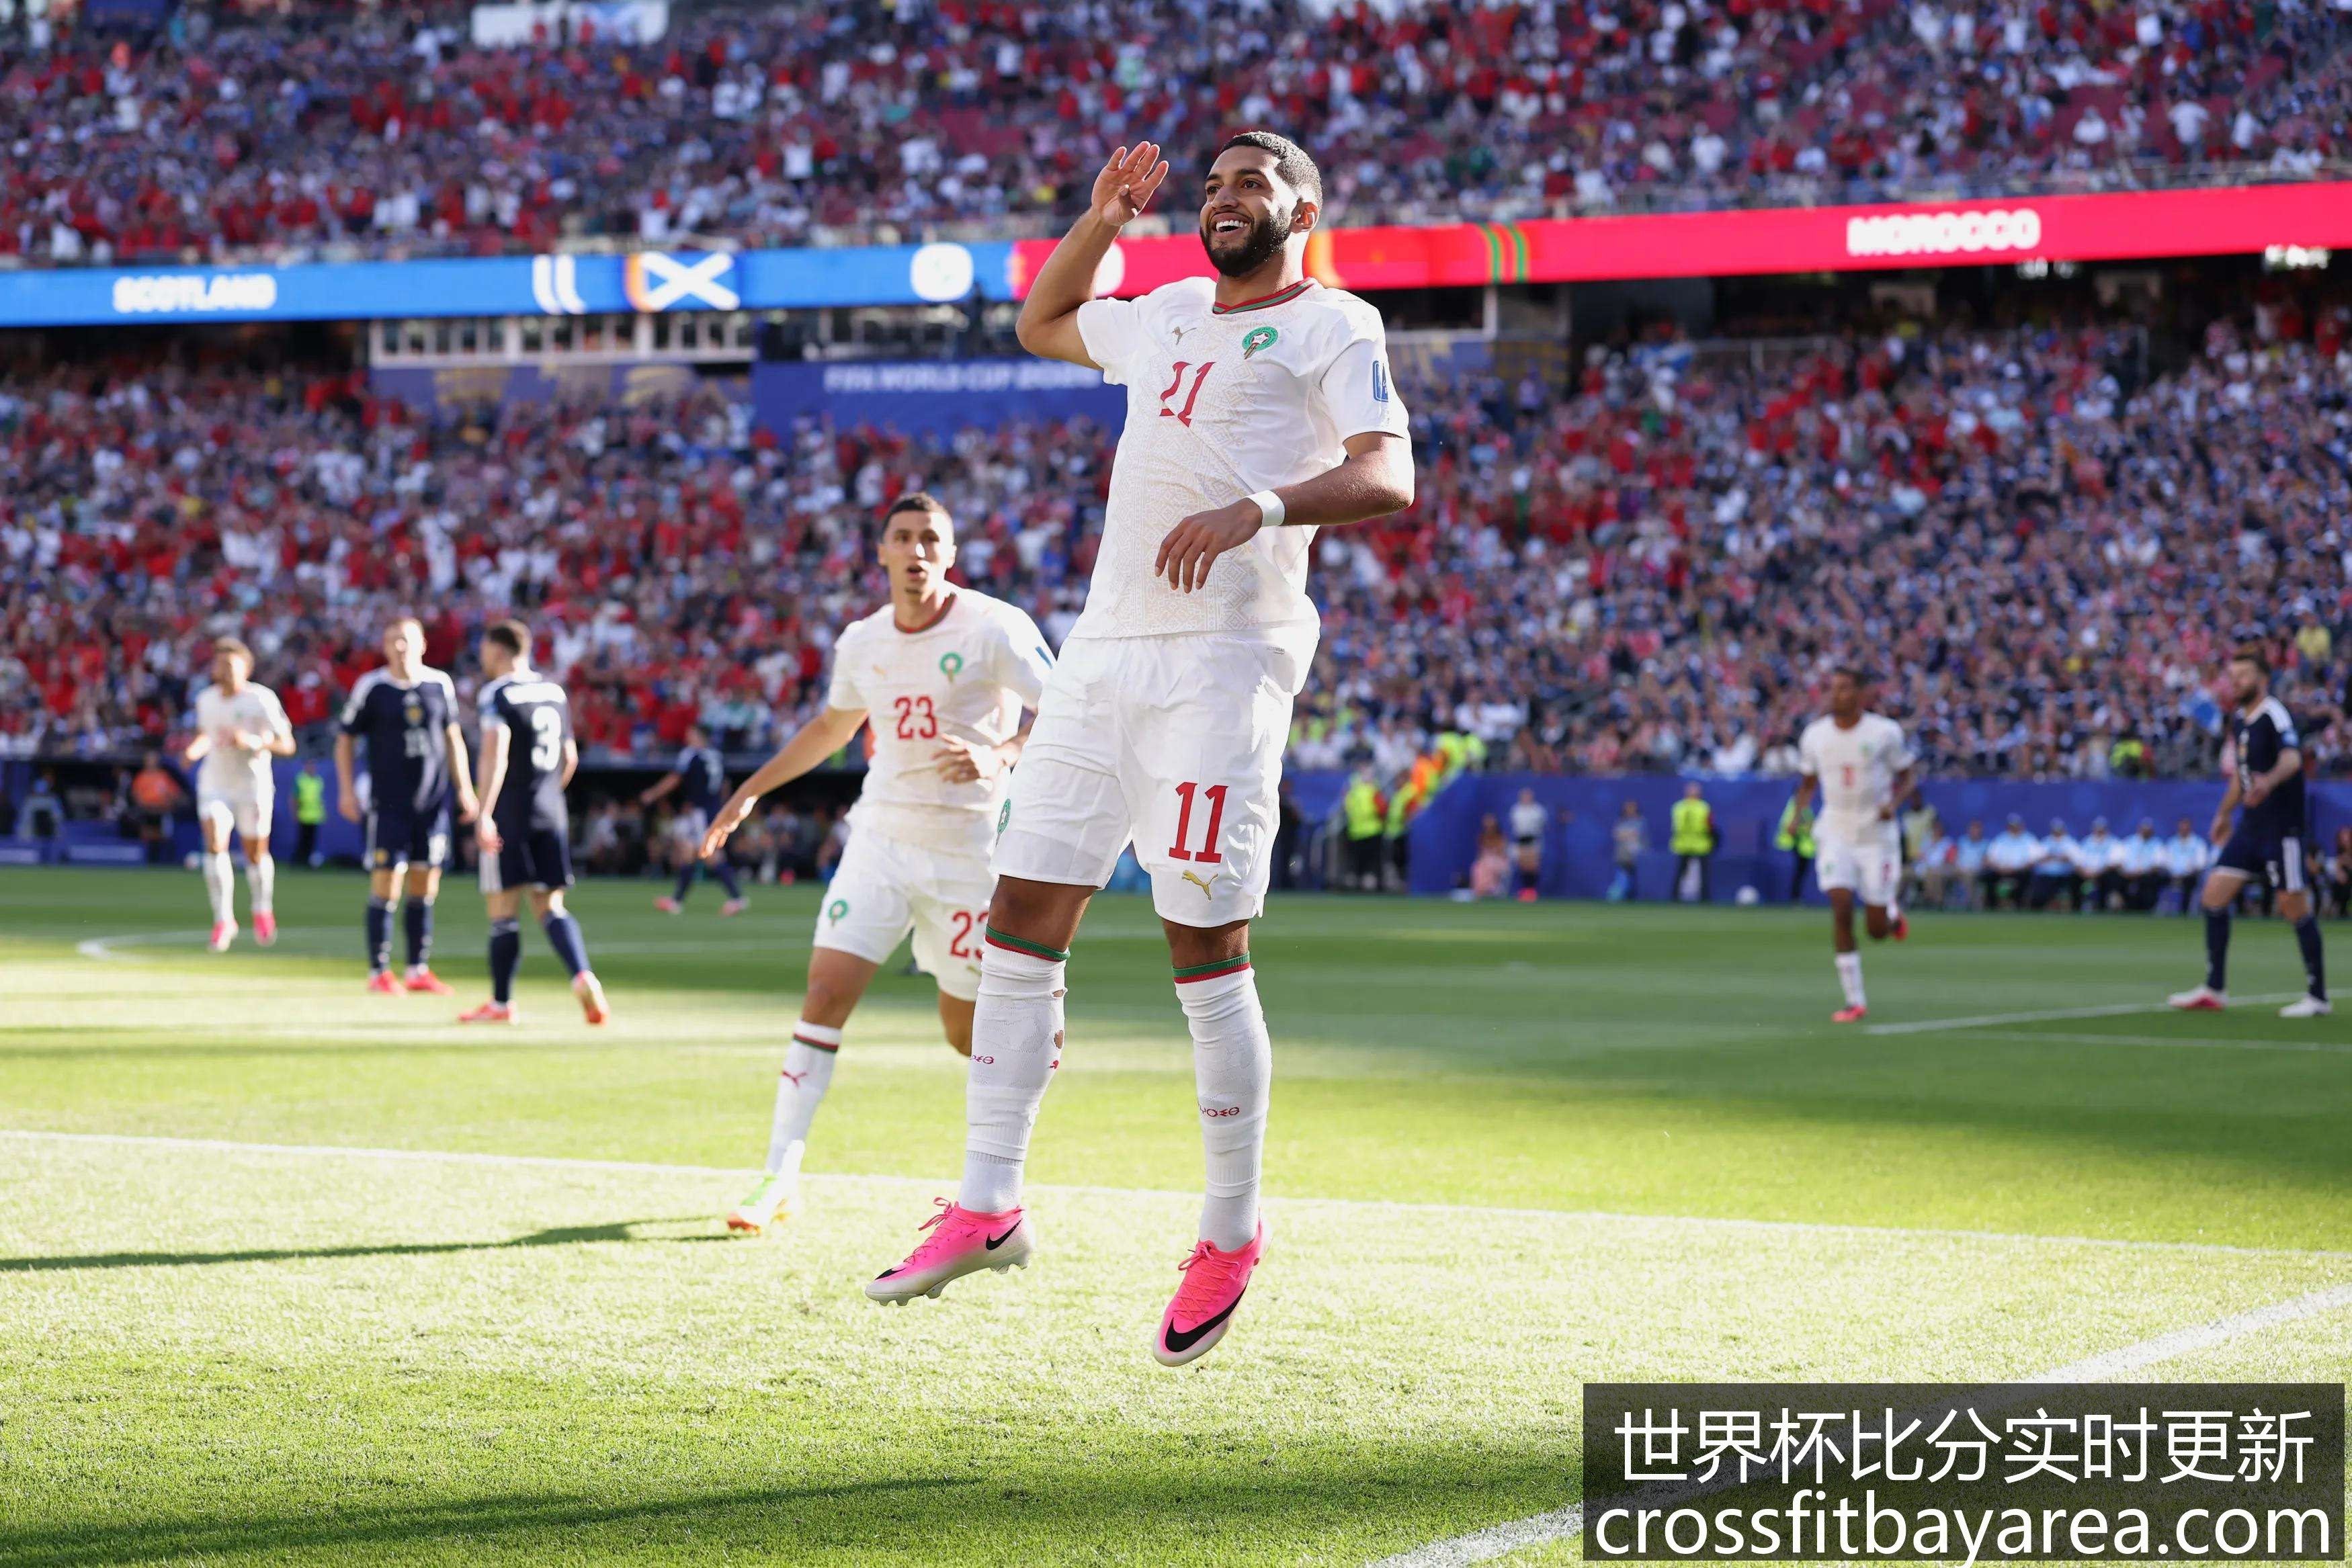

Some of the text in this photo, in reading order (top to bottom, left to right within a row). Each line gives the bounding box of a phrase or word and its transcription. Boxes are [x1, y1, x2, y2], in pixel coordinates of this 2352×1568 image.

[1847, 208, 2041, 256] MOROCCO
[113, 273, 277, 313] SCOTLAND
[532, 705, 561, 771] 3
[894, 696, 937, 740] 23
[1169, 781, 1229, 863] 11
